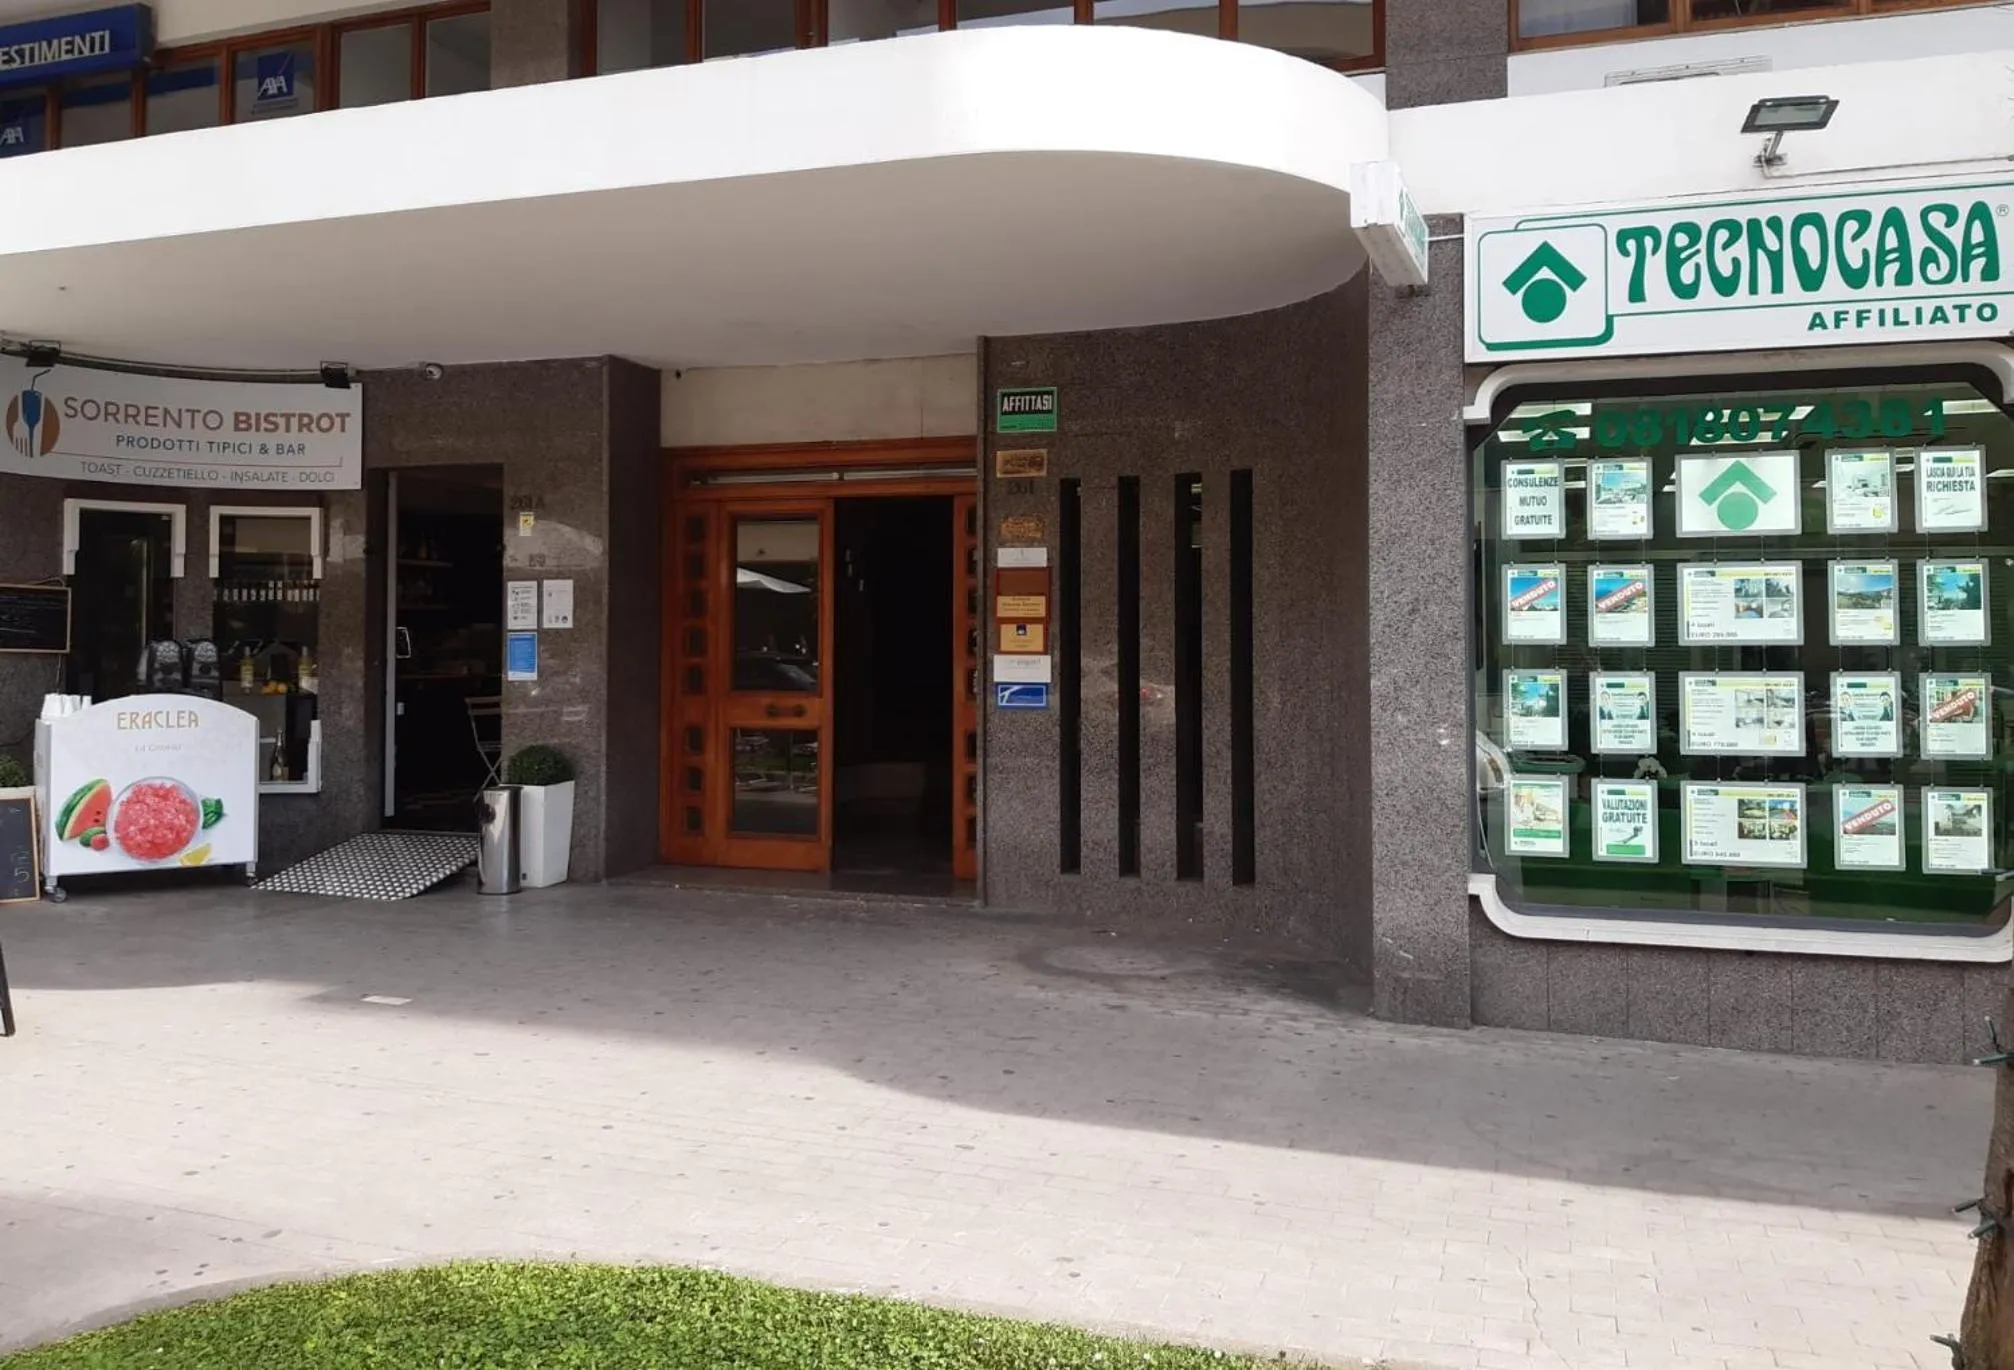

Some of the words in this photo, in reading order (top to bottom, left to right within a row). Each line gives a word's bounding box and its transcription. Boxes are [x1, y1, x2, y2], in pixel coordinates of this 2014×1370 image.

[258, 75, 288, 97] AXA
[1616, 201, 2000, 303] TECNOCASA
[1807, 302, 1998, 331] AFFILIATO
[1002, 394, 1052, 412] AFFITTASI
[64, 396, 224, 431] SORRENTO
[233, 411, 351, 433] BISTROT
[116, 434, 200, 453] PRODOTTI
[207, 440, 252, 455] TIPICI
[259, 443, 269, 455] &
[276, 443, 306, 456] BAR
[80, 461, 122, 476] TOAST
[132, 465, 219, 480] CUZZETIELLO
[230, 471, 288, 483] INSALATE
[300, 471, 335, 483] DOLCI
[1926, 466, 1945, 478] LASCIA
[1507, 476, 1559, 488] CONSULENZE
[1926, 480, 1976, 492] RICHIESTA
[1519, 496, 1548, 507] MUTUO
[1514, 514, 1553, 526] GRATUITE
[117, 710, 199, 731] ERACLEA
[1602, 799, 1648, 811] VALUTAZIONI
[1602, 812, 1648, 824] GRATUITE
[1844, 801, 1893, 831] VENDUTO
